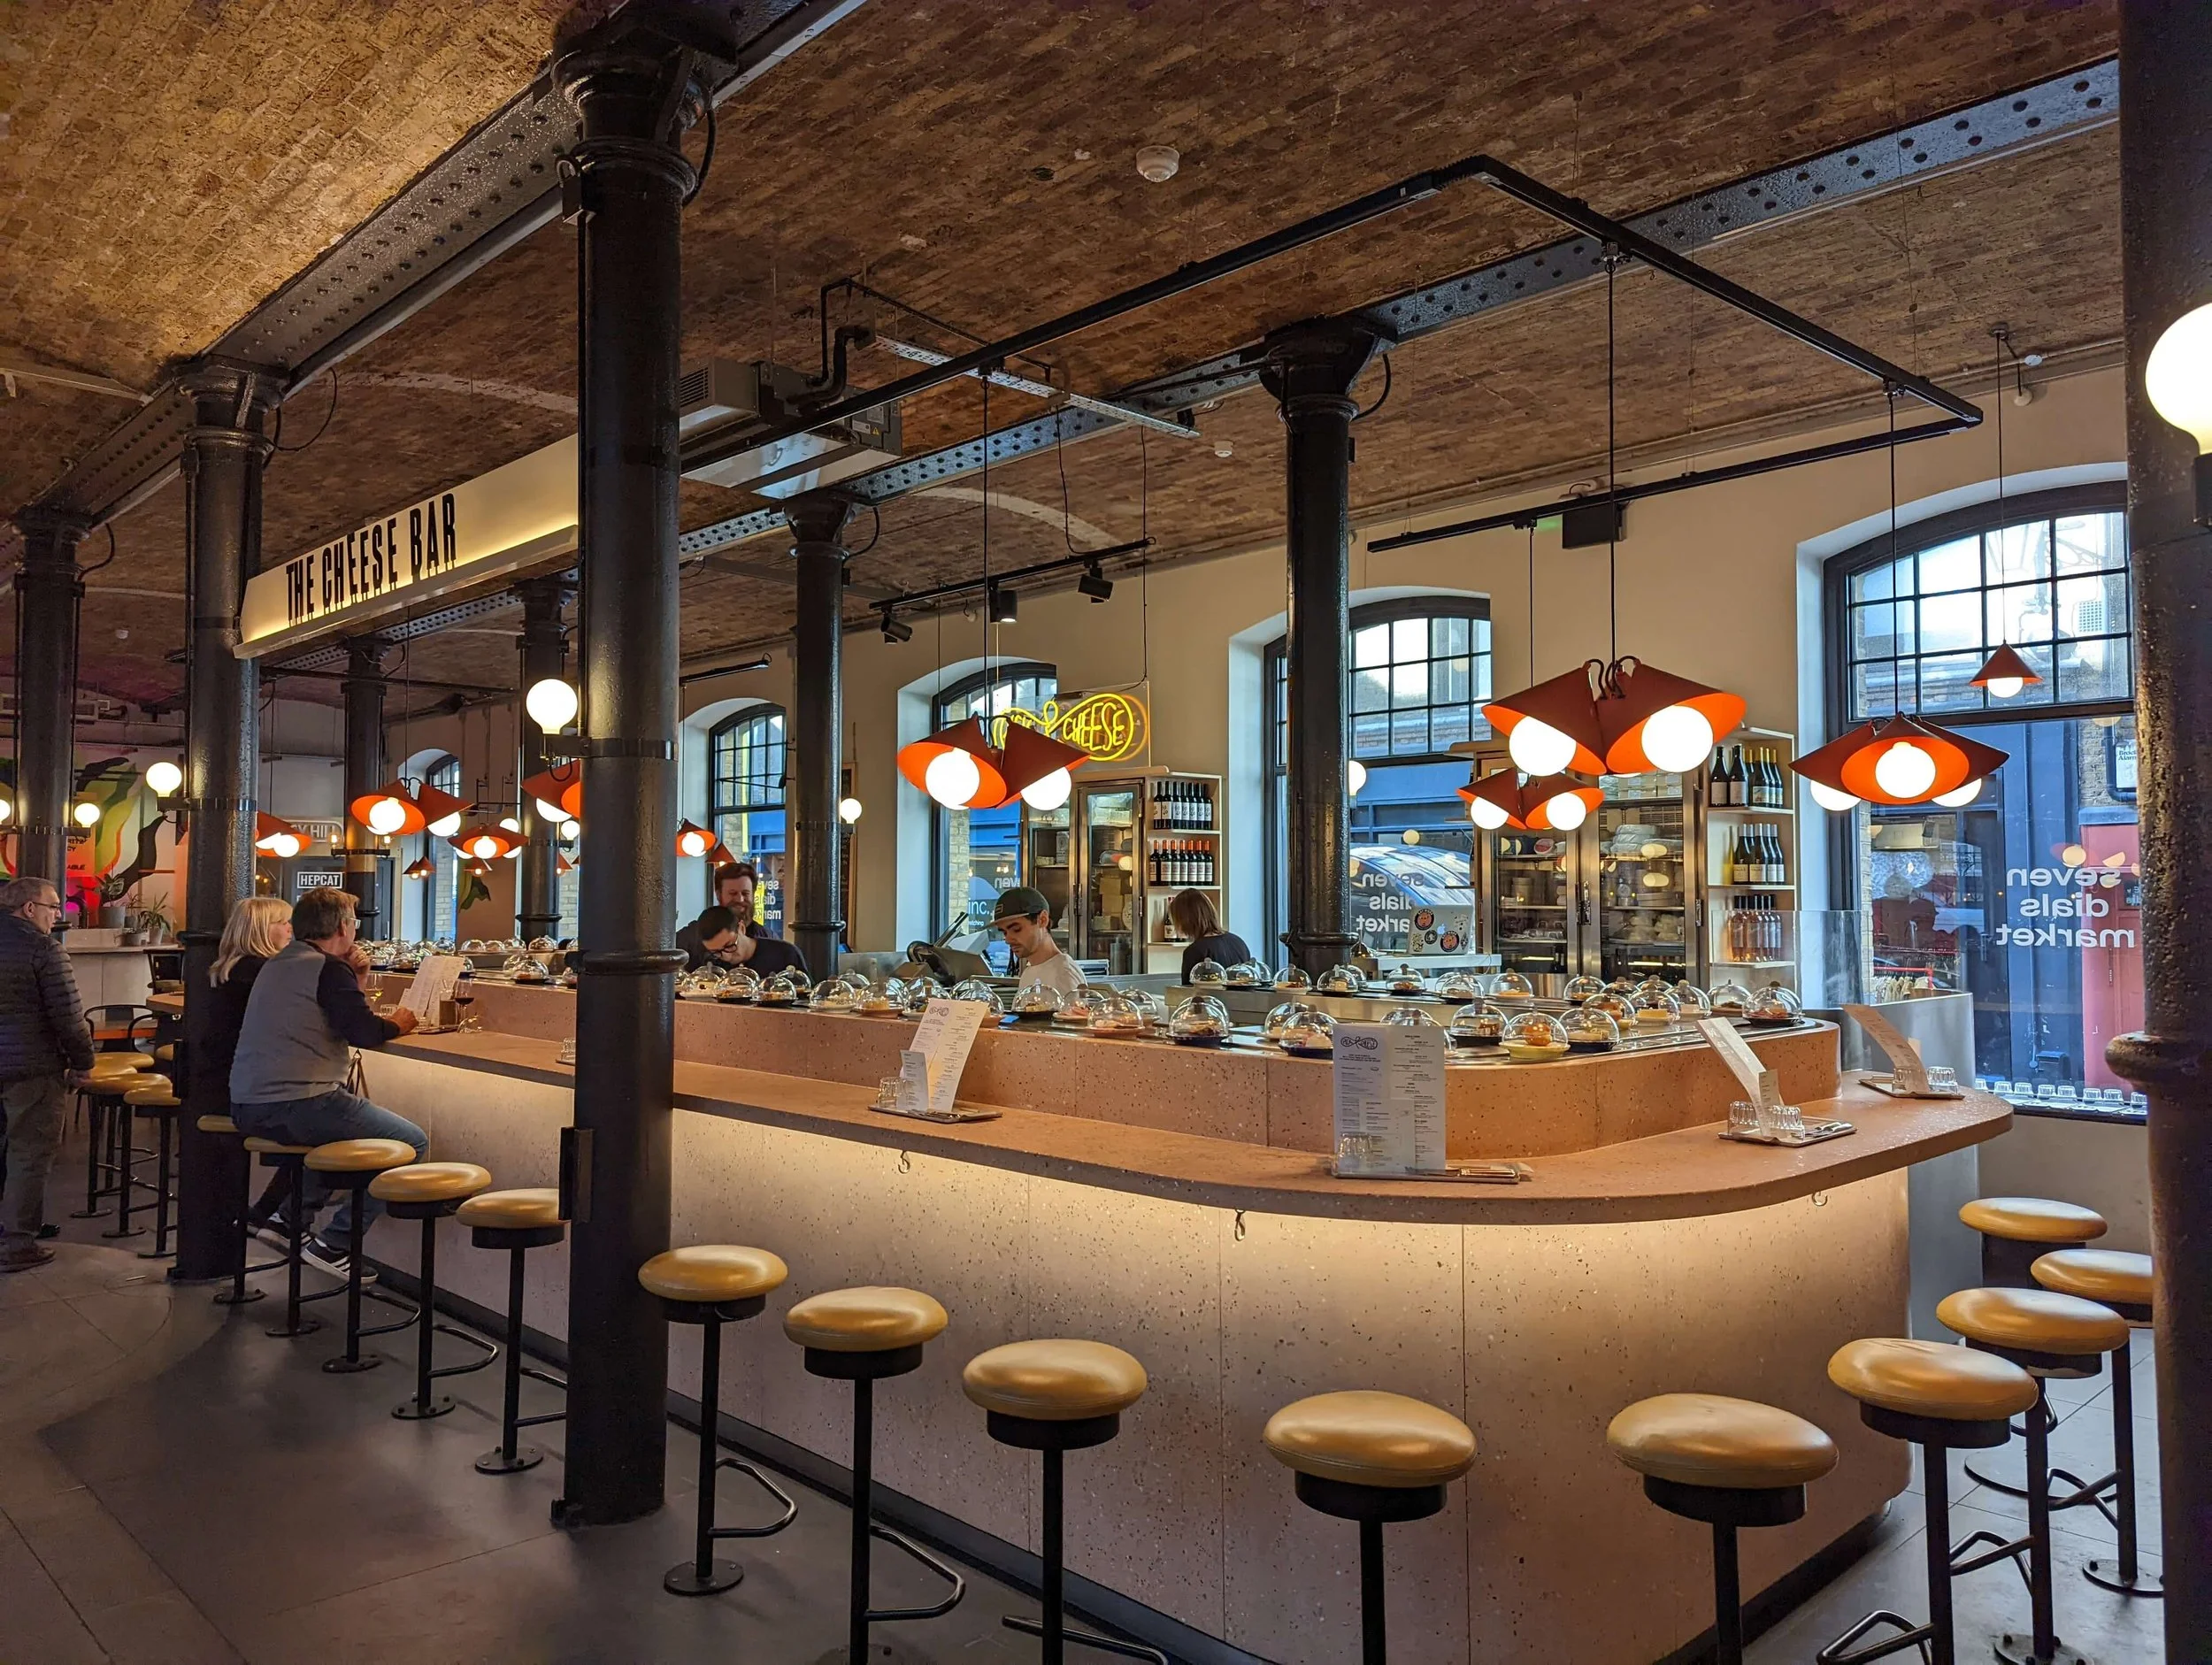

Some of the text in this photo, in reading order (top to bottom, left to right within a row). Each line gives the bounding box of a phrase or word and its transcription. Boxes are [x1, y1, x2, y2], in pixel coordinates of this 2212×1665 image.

[286, 493, 457, 621] THE CHEESE BAR
[1063, 702, 1125, 751] CHEESE
[300, 874, 340, 886] HEPCAT
